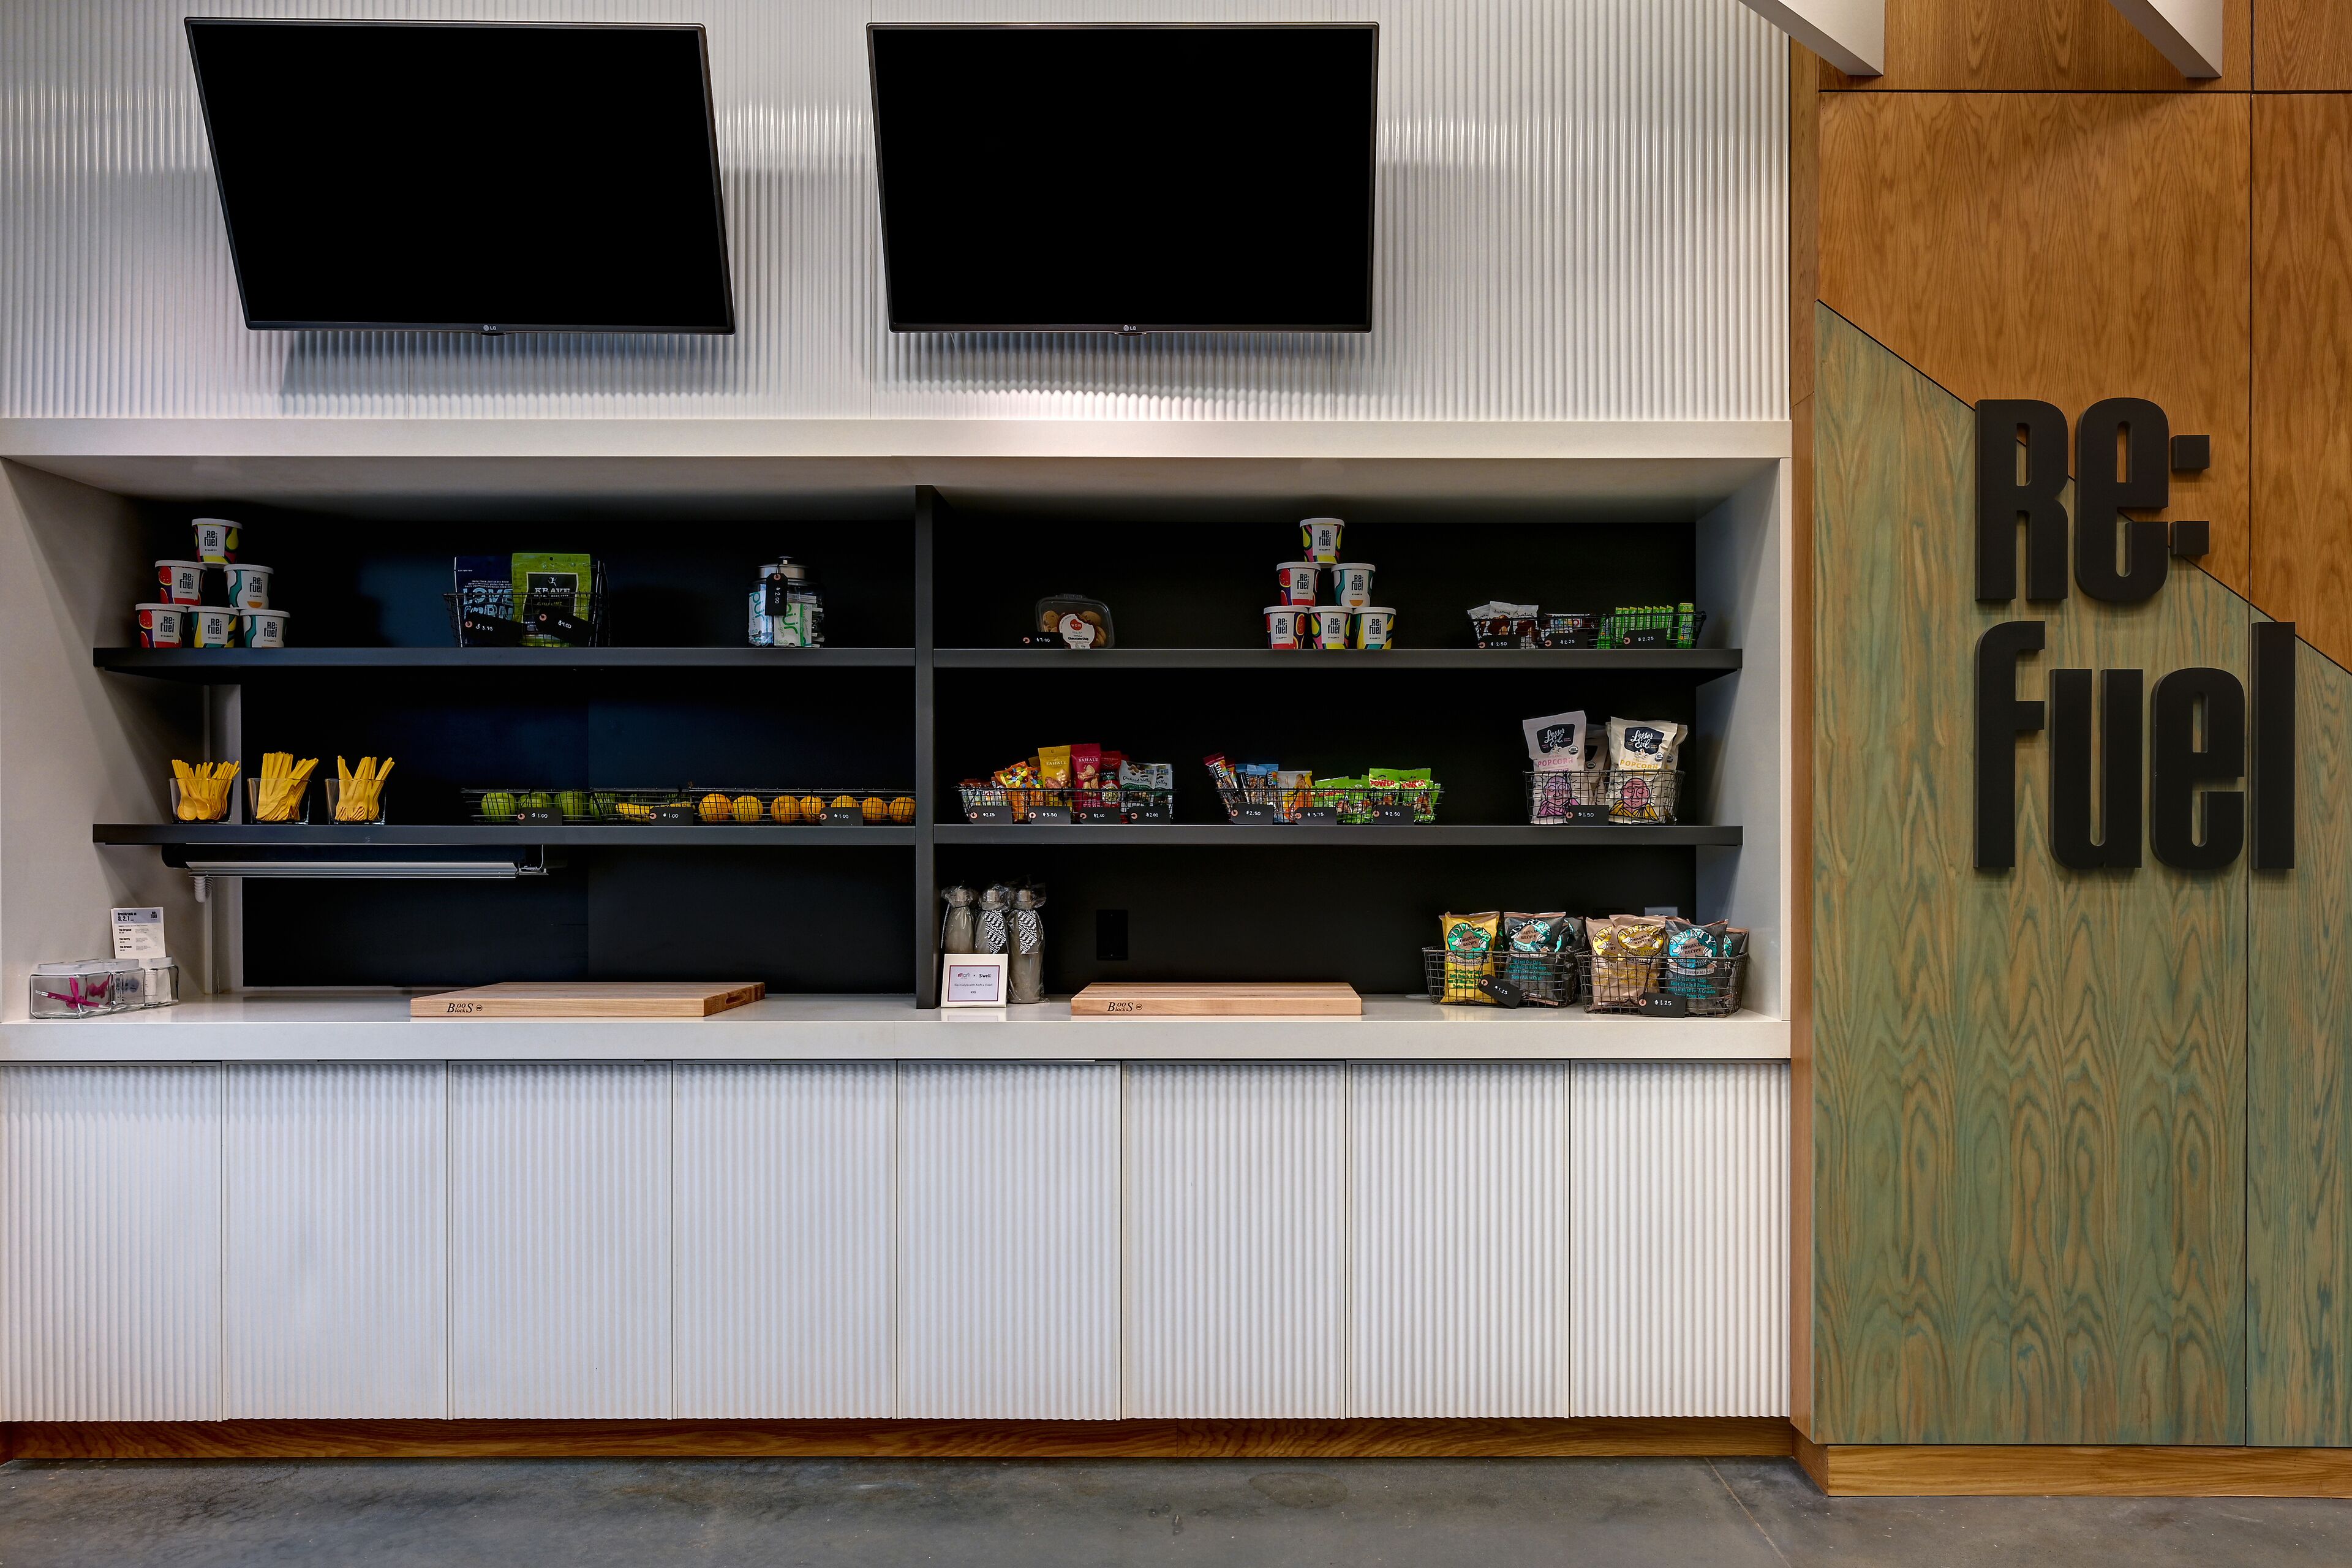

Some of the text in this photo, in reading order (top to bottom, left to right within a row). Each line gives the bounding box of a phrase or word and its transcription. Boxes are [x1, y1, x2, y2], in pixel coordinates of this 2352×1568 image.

[205, 537, 217, 546] fuel
[1319, 537, 1331, 546] fuel
[179, 579, 194, 589] fuel
[250, 583, 262, 593] fuel
[1297, 580, 1309, 590] fuel
[1351, 581, 1363, 591] fuel
[463, 588, 513, 606] LOVE
[160, 622, 174, 633] fuel
[208, 624, 222, 635] fuel
[264, 627, 277, 638] fuel
[1276, 624, 1287, 634] fuel
[1328, 625, 1340, 634] fuel
[1370, 625, 1381, 635] fuel
[1973, 621, 2296, 870] fuel
[1538, 757, 1574, 766] POPCORN
[1620, 760, 1659, 769] POPCORN
[1214, 763, 1224, 778] KIND
[1673, 929, 1717, 944] DIRTY
